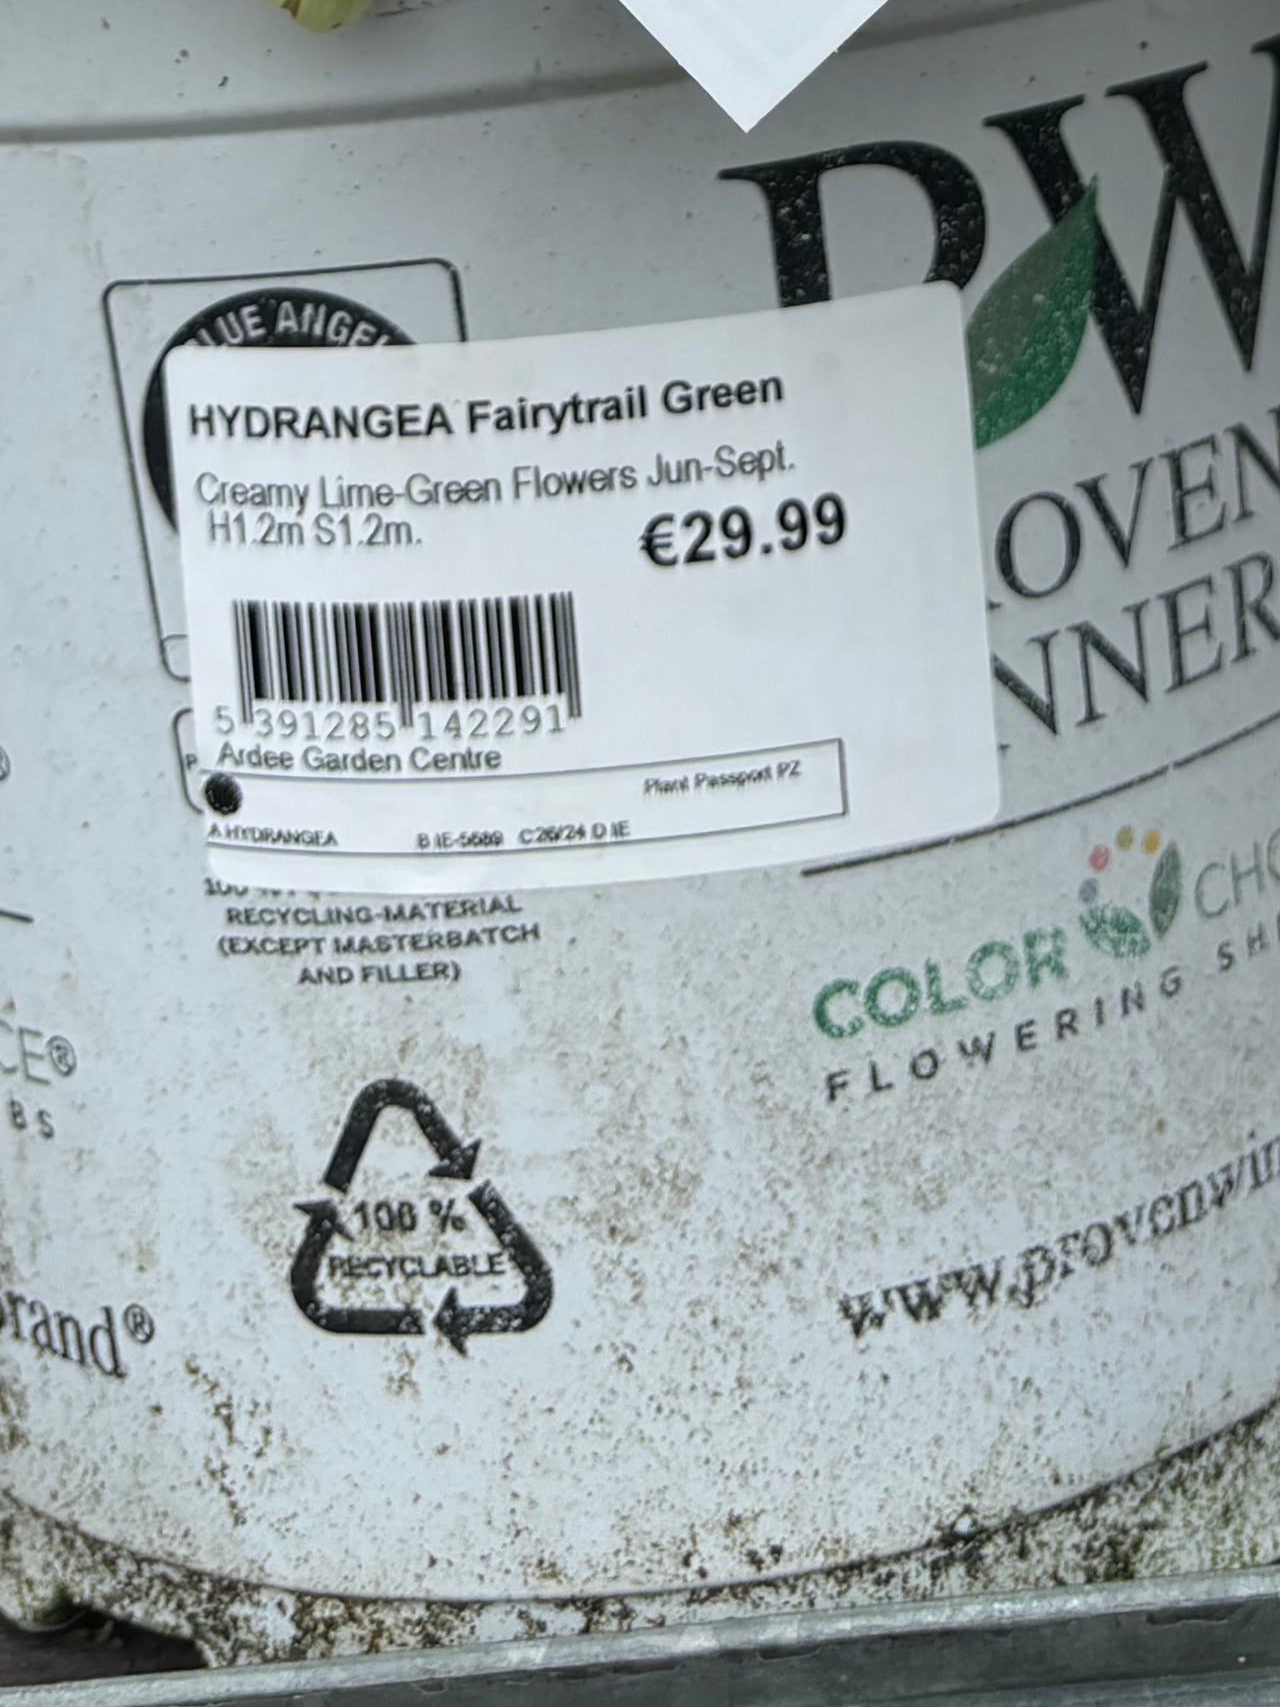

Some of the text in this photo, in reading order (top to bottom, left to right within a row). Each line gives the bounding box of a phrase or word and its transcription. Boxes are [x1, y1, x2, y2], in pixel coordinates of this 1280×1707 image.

[188, 374, 785, 441] HYDRANGEA Fairytrail Green
[195, 439, 797, 516] Creamy Lime-Green Flowers Jun-Sept.
[209, 508, 424, 548] H1.2m S1.2m.
[638, 490, 848, 568] €29.99
[253, 707, 398, 742] 391285
[417, 703, 568, 742] 142291
[216, 740, 503, 773] Ardee Garden Centre
[224, 824, 340, 848] HYDRANGEA
[224, 893, 526, 927] RECYCLING-MATERIAL
[217, 921, 542, 958] (EXCEPT MASTERBATCH
[297, 958, 463, 987] AND FILLER)
[811, 925, 1070, 1041] COLOR
[823, 963, 1185, 1104] FLOWERING
[352, 1199, 418, 1233] 100
[327, 1251, 508, 1280] RECYCLABLE
